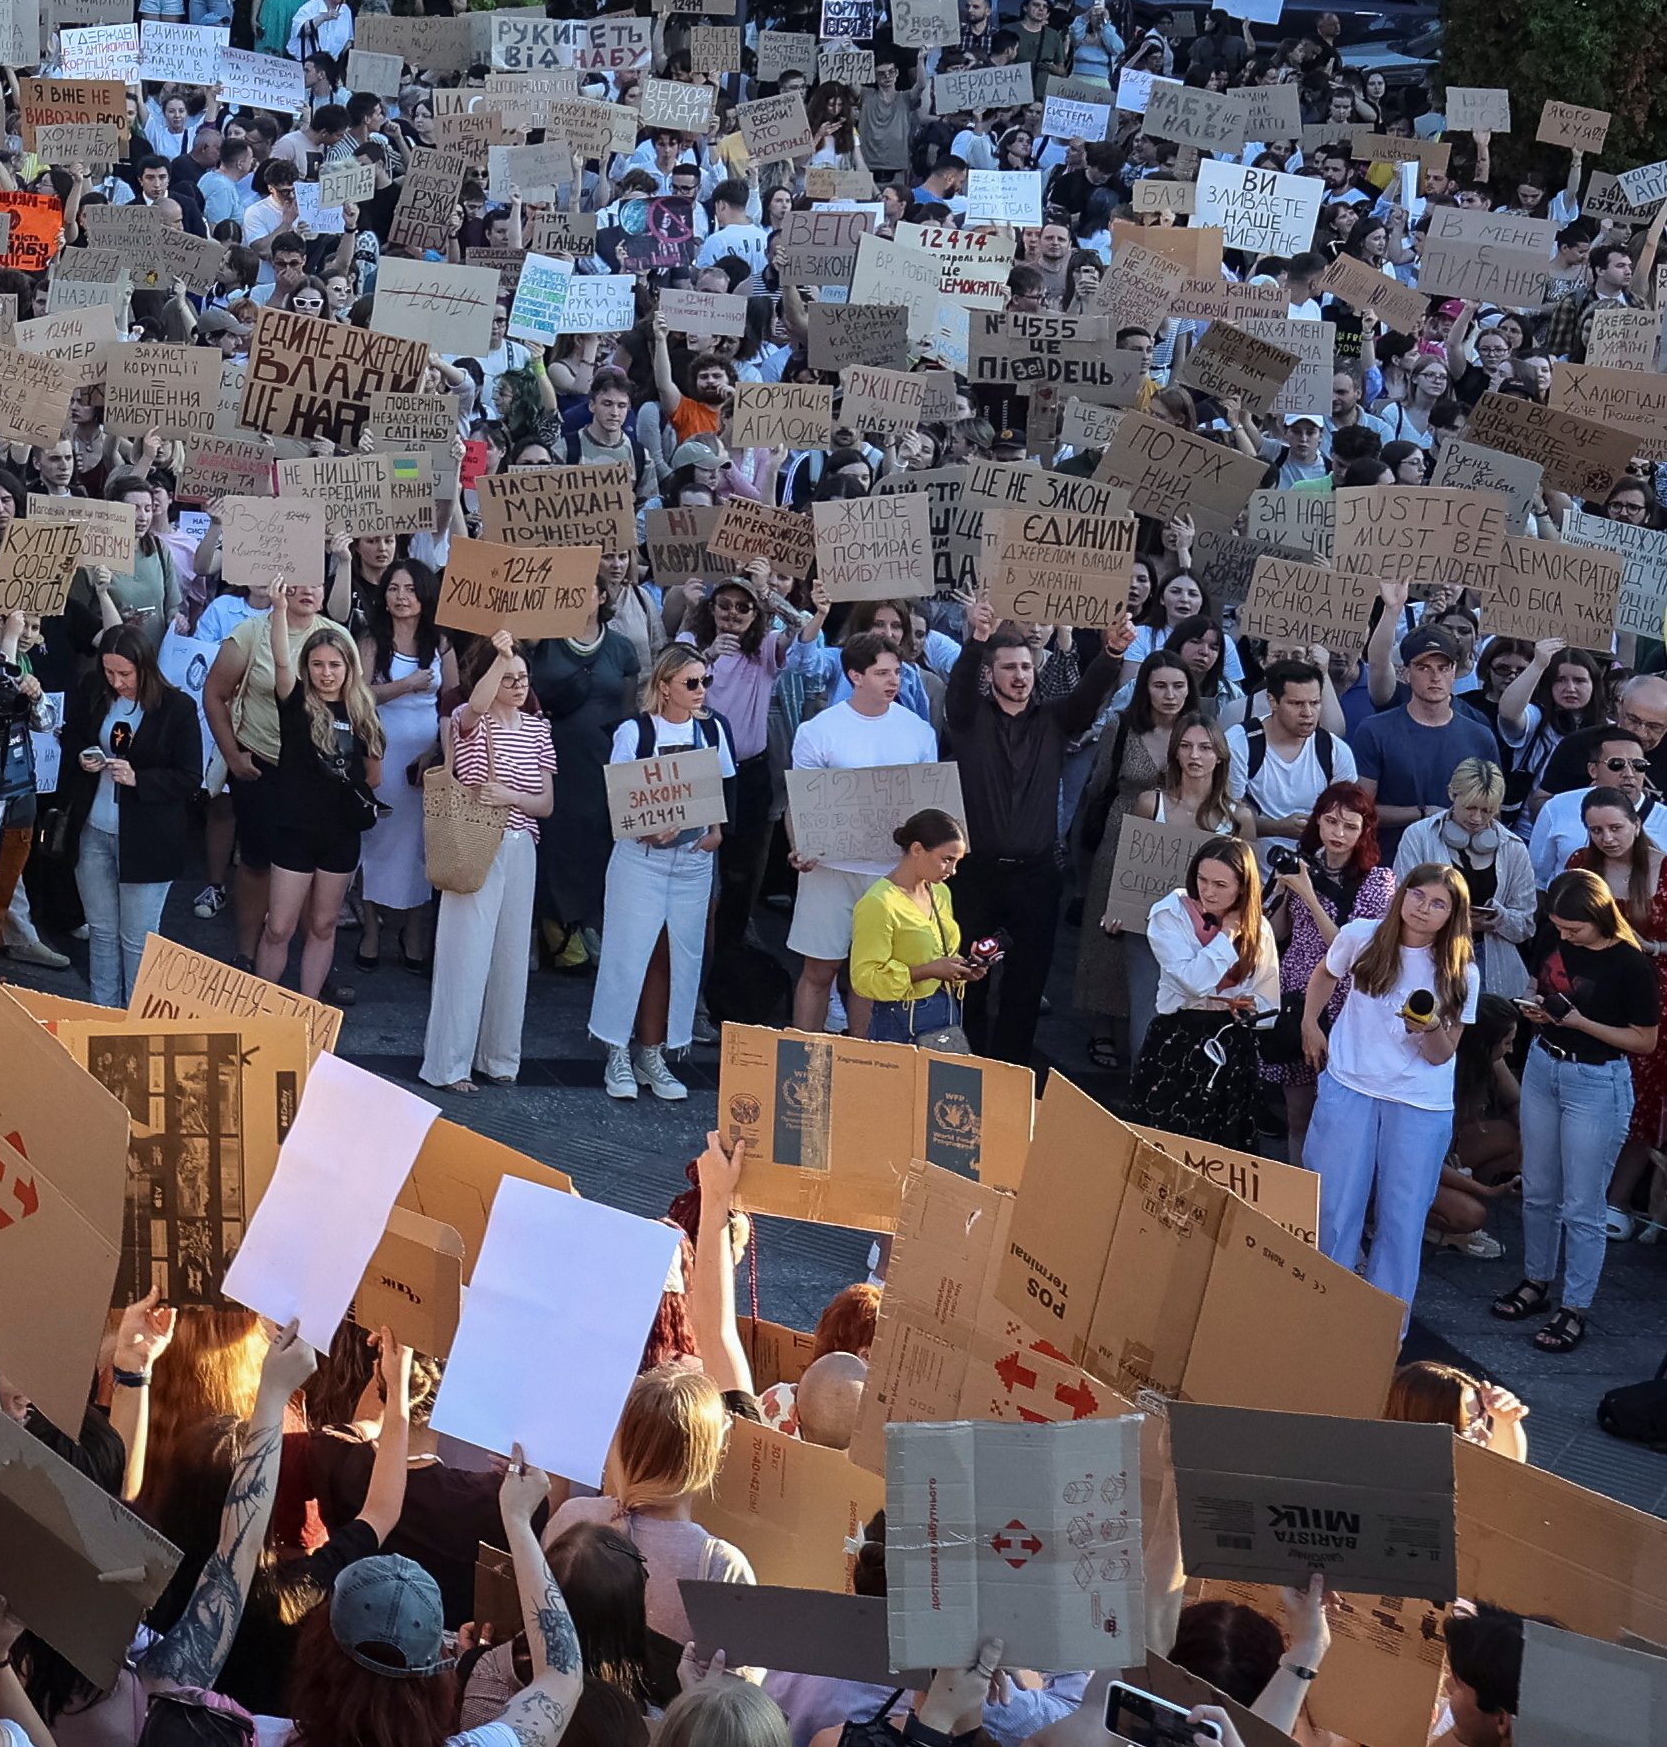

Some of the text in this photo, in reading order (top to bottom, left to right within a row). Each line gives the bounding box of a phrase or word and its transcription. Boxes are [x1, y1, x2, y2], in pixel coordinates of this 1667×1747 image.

[498, 19, 637, 48] РУКИ ГЕТЬ
[505, 46, 648, 70] ВІД НАБУ
[946, 67, 1023, 95] ВЕРХОВНА
[50, 87, 86, 106] ВЖЕ
[91, 88, 112, 107] НЕ
[956, 87, 1019, 107] ЗРАДА
[1244, 171, 1278, 196] ВИ
[1206, 185, 1306, 218] ЗЛИВАЄТЕ
[1225, 208, 1281, 231] НАШЕ
[1441, 213, 1545, 247] В МЕНЕ
[919, 229, 988, 252] 12414
[1011, 315, 1078, 338] 4555
[135, 346, 187, 360] ЗАХИСТ
[257, 312, 428, 375] ЄДИНЕ ДЖЕРЕЛО
[1029, 339, 1061, 353] ЦЕ
[109, 386, 200, 408] ЗНИЩЕННЯ
[385, 396, 446, 412] ПОВЕРНІТЬ
[737, 387, 830, 412] КОРУПЦІЯ
[1127, 426, 1233, 483] ПОТУХ
[283, 459, 387, 486] НЕ НИЩІТЬ
[489, 465, 629, 498] НАСТУПНИЙ
[970, 471, 1111, 515] ЦЕ НЕ ЗАКОН
[504, 493, 624, 523] МАЙДАН
[838, 500, 895, 523] ЖИВЕ
[1342, 494, 1505, 533] JUSTICE
[1021, 516, 1137, 554] ЄДИНИМ
[1357, 524, 1492, 560] MUST BE
[832, 538, 924, 563] ПОМИРАЄ
[1001, 543, 1125, 573] ДЖЕРЕЛОМ ВЛАДИ
[491, 556, 554, 580] #12414
[1006, 569, 1085, 595] В УКРАЇНІ
[1262, 563, 1365, 598] ДУШІТЬ
[1335, 553, 1498, 591] INDEPENDENT
[1499, 544, 1620, 593] ДЕМОКРАТІЯ
[450, 576, 484, 607] YOU
[552, 583, 587, 610] PASS
[1493, 588, 1614, 625] ДО БІСА ТАКА
[1012, 591, 1127, 628] Є НАРОД!
[643, 762, 680, 786] НІ
[628, 783, 694, 810] ЗАКОНУ
[620, 805, 687, 830] #12414
[1011, 1242, 1069, 1298] Terminal
[1027, 1277, 1066, 1320] POS
[1266, 1504, 1360, 1534] MILK
[1275, 1530, 1357, 1549] BARISTA
